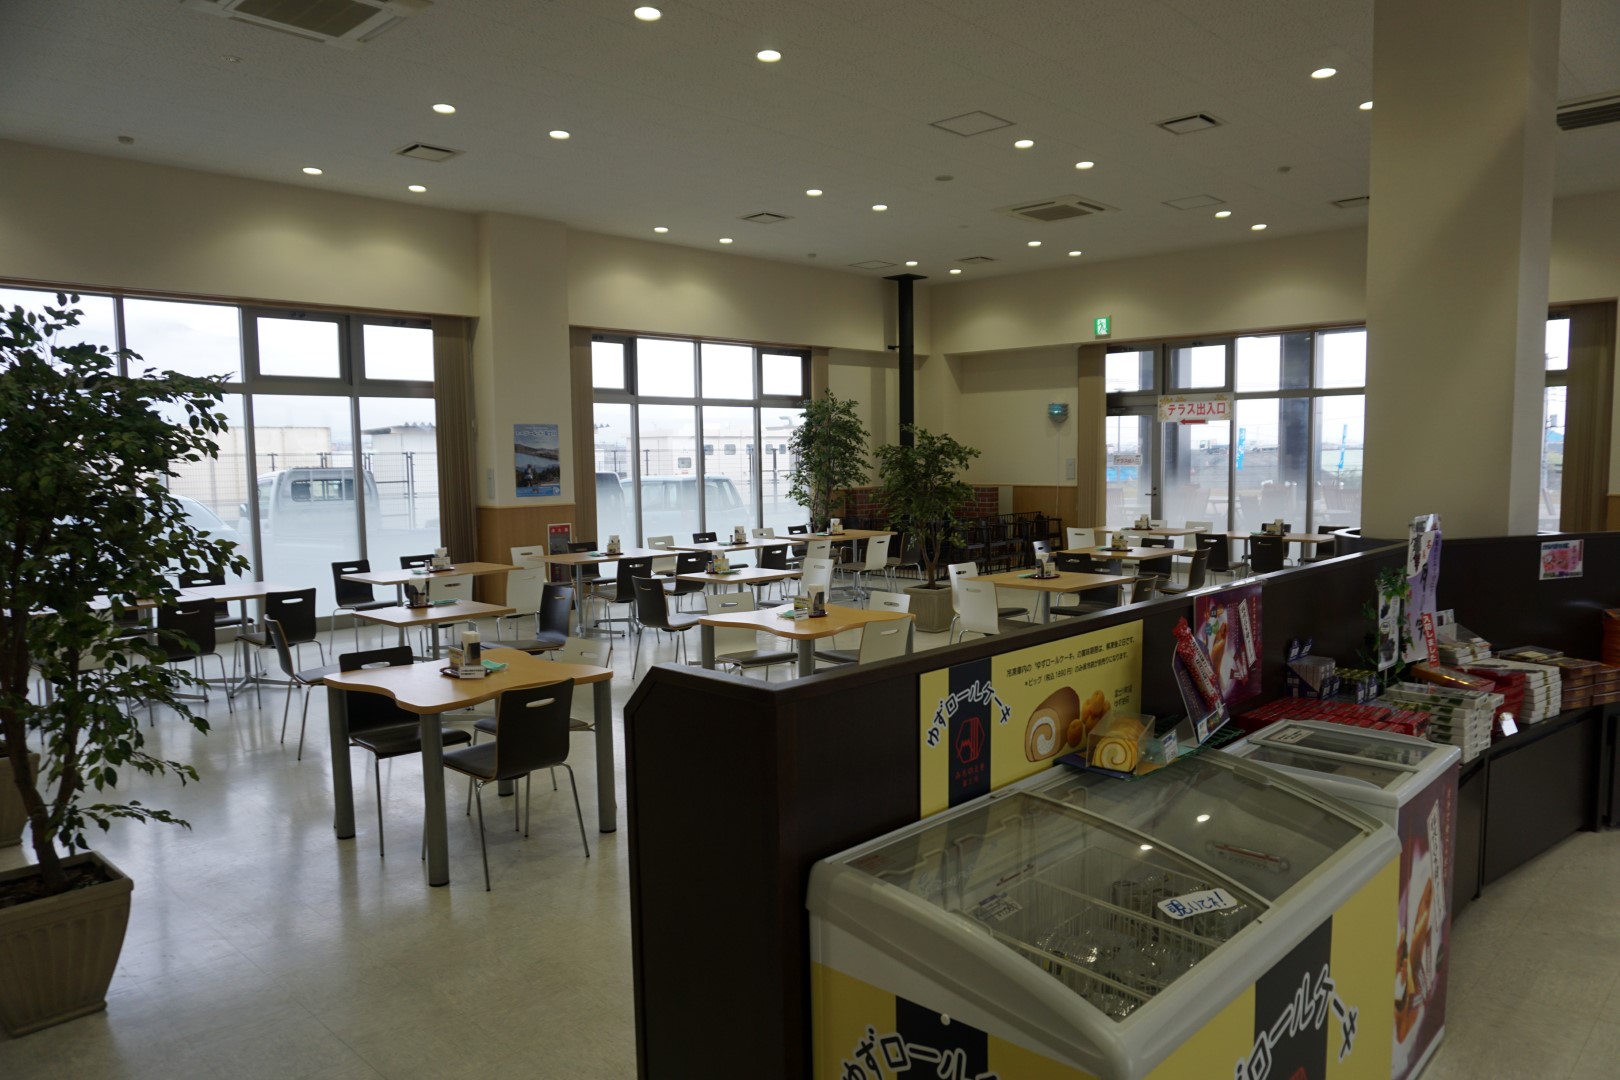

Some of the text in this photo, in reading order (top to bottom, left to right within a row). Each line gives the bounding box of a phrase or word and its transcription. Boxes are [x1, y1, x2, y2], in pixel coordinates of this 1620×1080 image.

[1167, 402, 1226, 416] テラス出入口
[1423, 615, 1438, 663] 入荷しました
[927, 680, 1011, 747] ゆずロールケーキ
[1237, 964, 1357, 1080] ロールケーキ
[841, 1026, 998, 1080] ゆずロール
